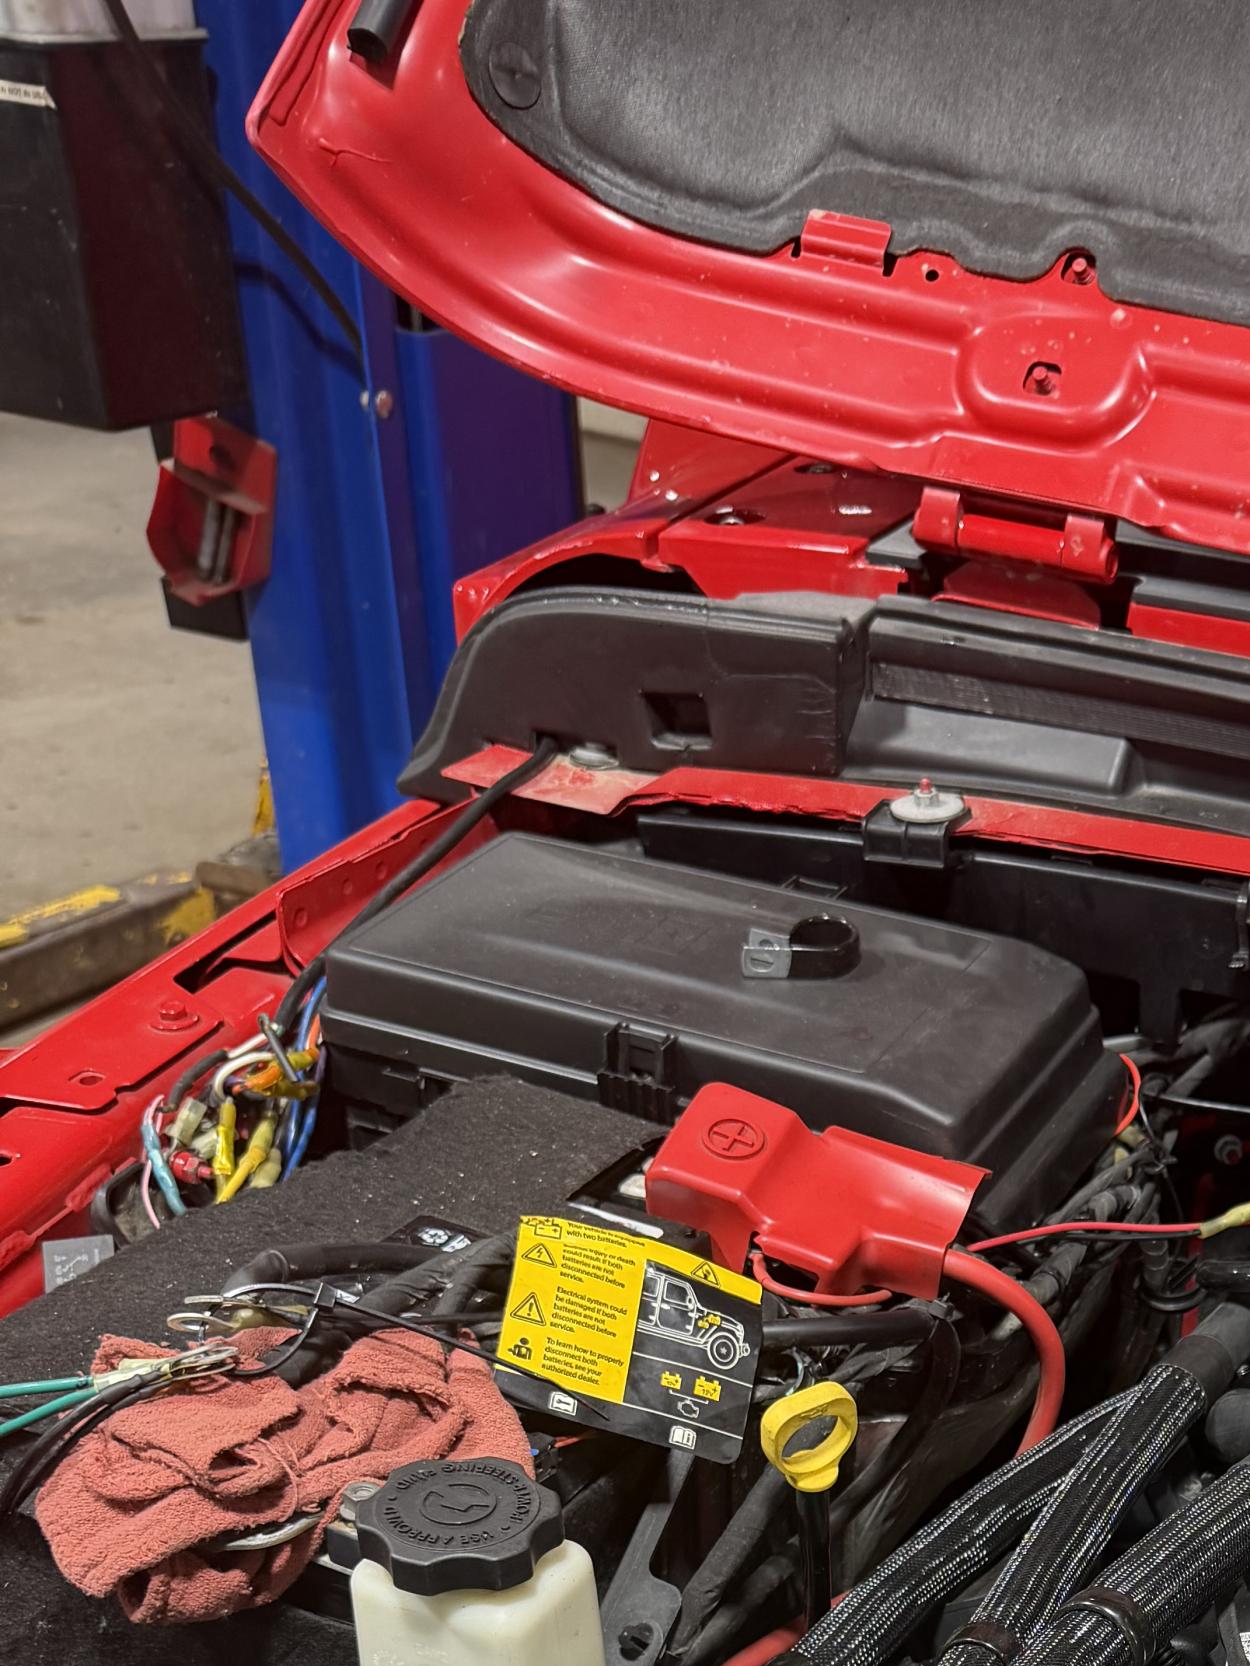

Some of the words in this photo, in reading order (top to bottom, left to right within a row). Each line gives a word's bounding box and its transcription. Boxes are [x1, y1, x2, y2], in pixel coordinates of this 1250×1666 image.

[582, 1232, 596, 1241] two
[604, 1276, 625, 1288] before
[555, 1294, 565, 1302] be
[564, 1297, 596, 1314] damaged
[601, 1310, 617, 1320] both
[556, 1286, 586, 1301] Electrical
[585, 1295, 609, 1309] system
[609, 1304, 627, 1315] could
[551, 1311, 596, 1330] disconnected
[595, 1326, 616, 1337] before
[553, 1303, 582, 1317] batteries
[582, 1313, 593, 1321] are
[593, 1316, 605, 1325] not
[544, 1345, 581, 1362] disconnect
[581, 1356, 598, 1367] both
[545, 1336, 555, 1345] To
[555, 1340, 573, 1351] learn
[573, 1345, 588, 1355] how
[596, 1353, 624, 1367] properly
[541, 1361, 577, 1378] authorized
[574, 1364, 585, 1372] see
[586, 1367, 602, 1378] your
